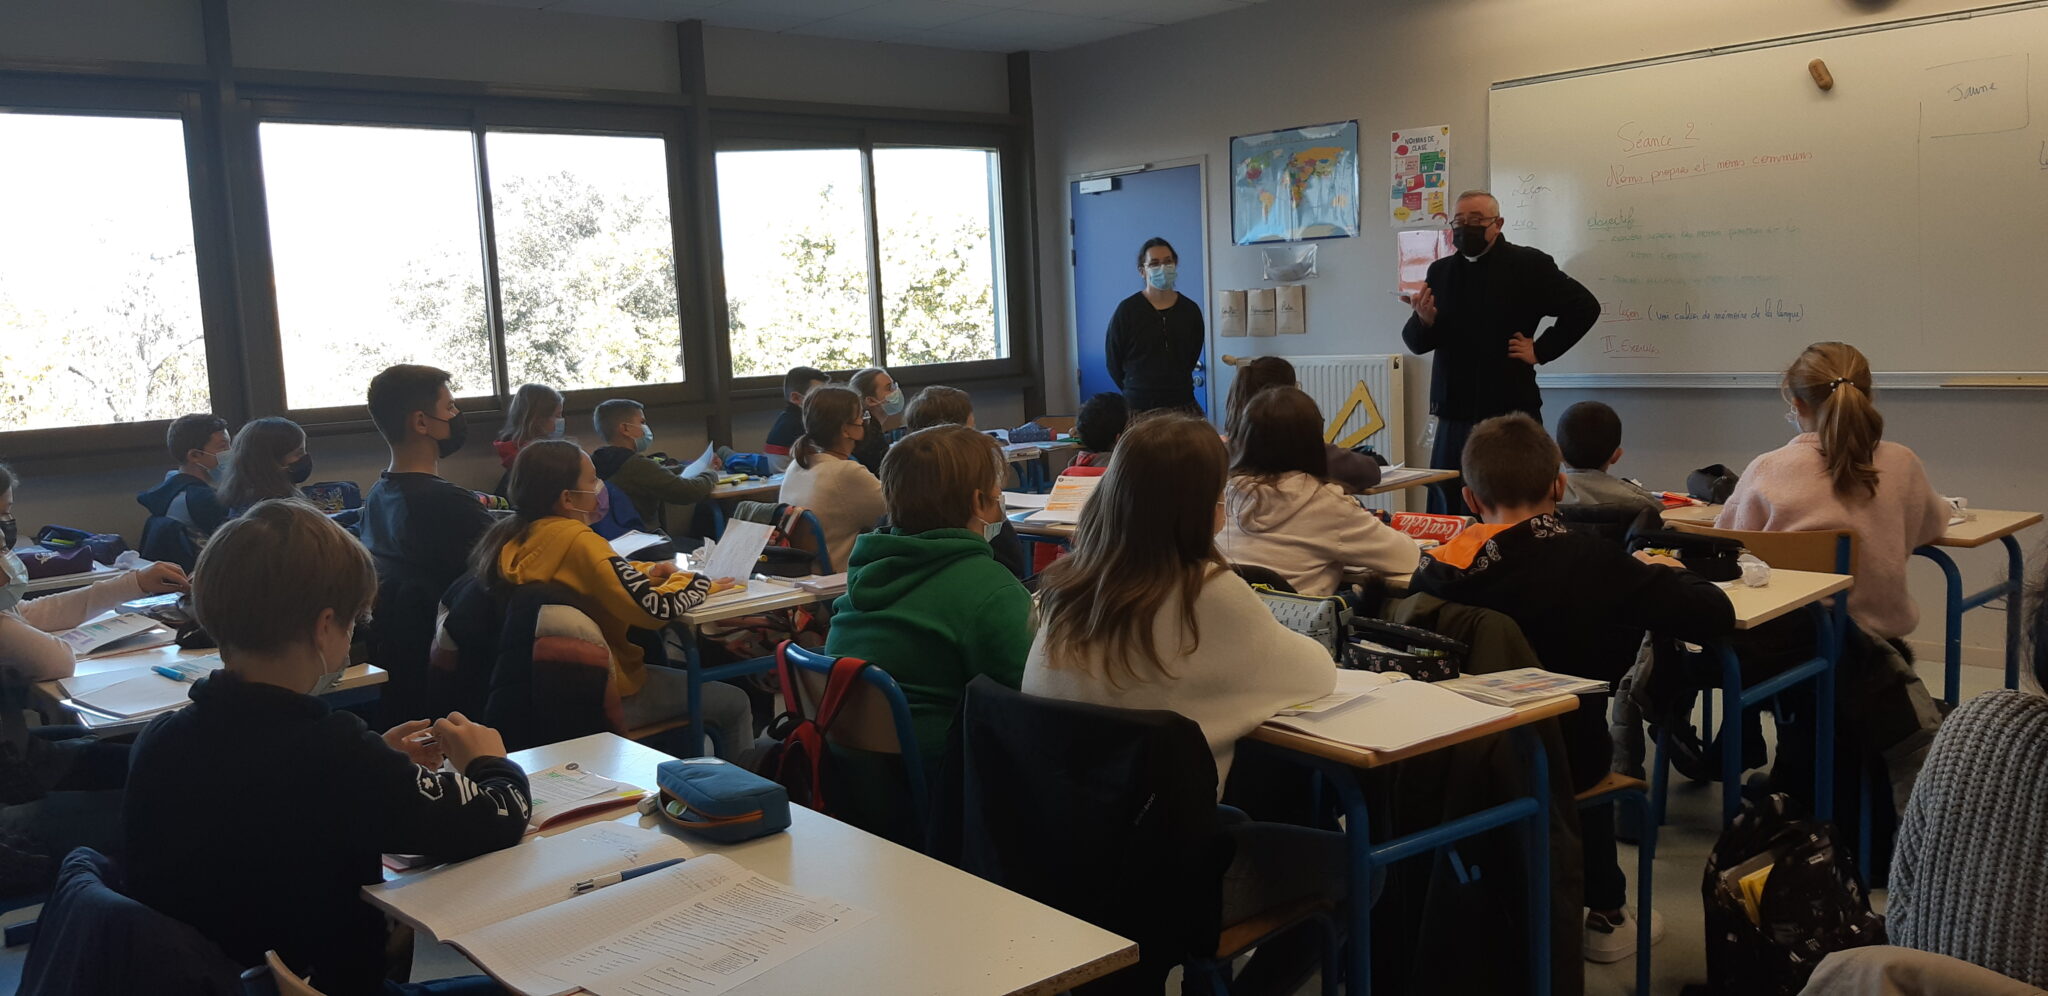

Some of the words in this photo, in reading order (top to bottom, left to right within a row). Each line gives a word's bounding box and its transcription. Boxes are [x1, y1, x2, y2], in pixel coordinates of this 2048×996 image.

[1616, 121, 1672, 152] Séance
[1685, 122, 1700, 141] 2
[1694, 158, 1708, 173] et
